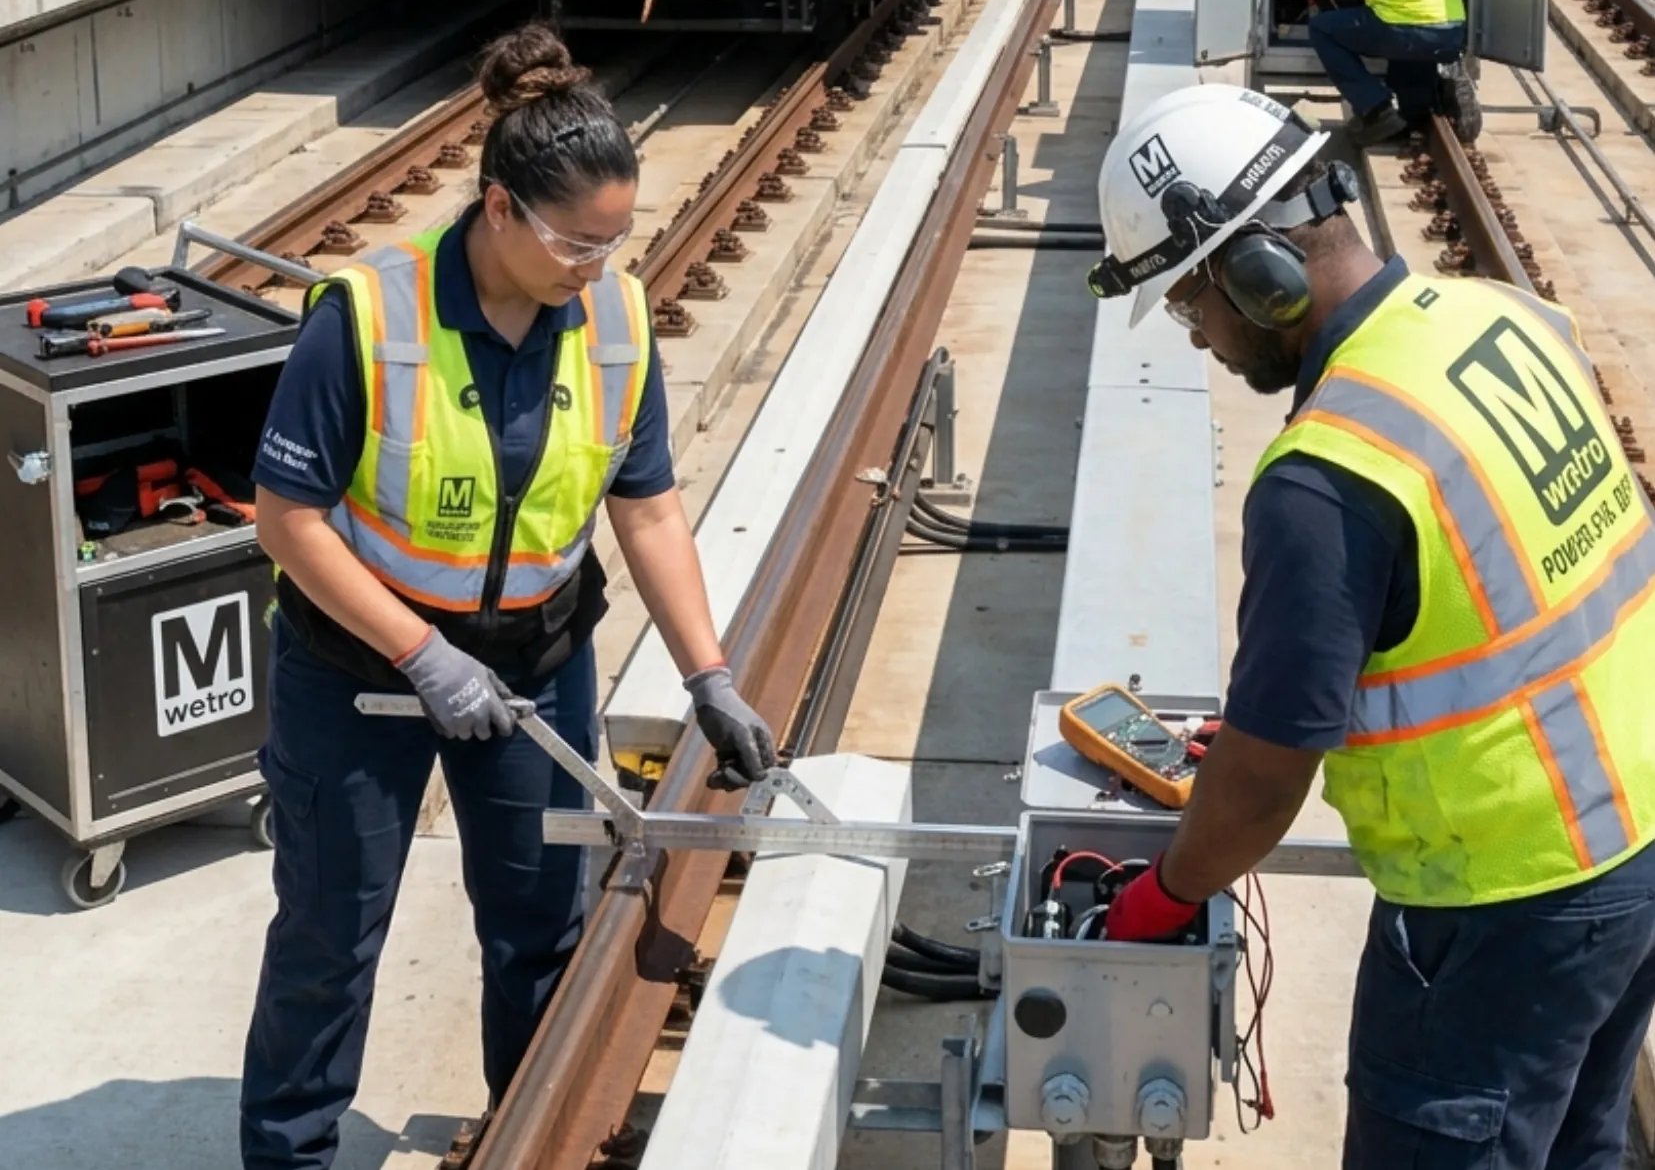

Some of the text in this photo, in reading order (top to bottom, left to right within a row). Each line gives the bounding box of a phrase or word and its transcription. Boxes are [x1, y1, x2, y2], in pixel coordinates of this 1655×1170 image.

[1131, 135, 1173, 186] M
[1458, 327, 1585, 477] M
[442, 478, 472, 509] M
[160, 599, 245, 700] M
